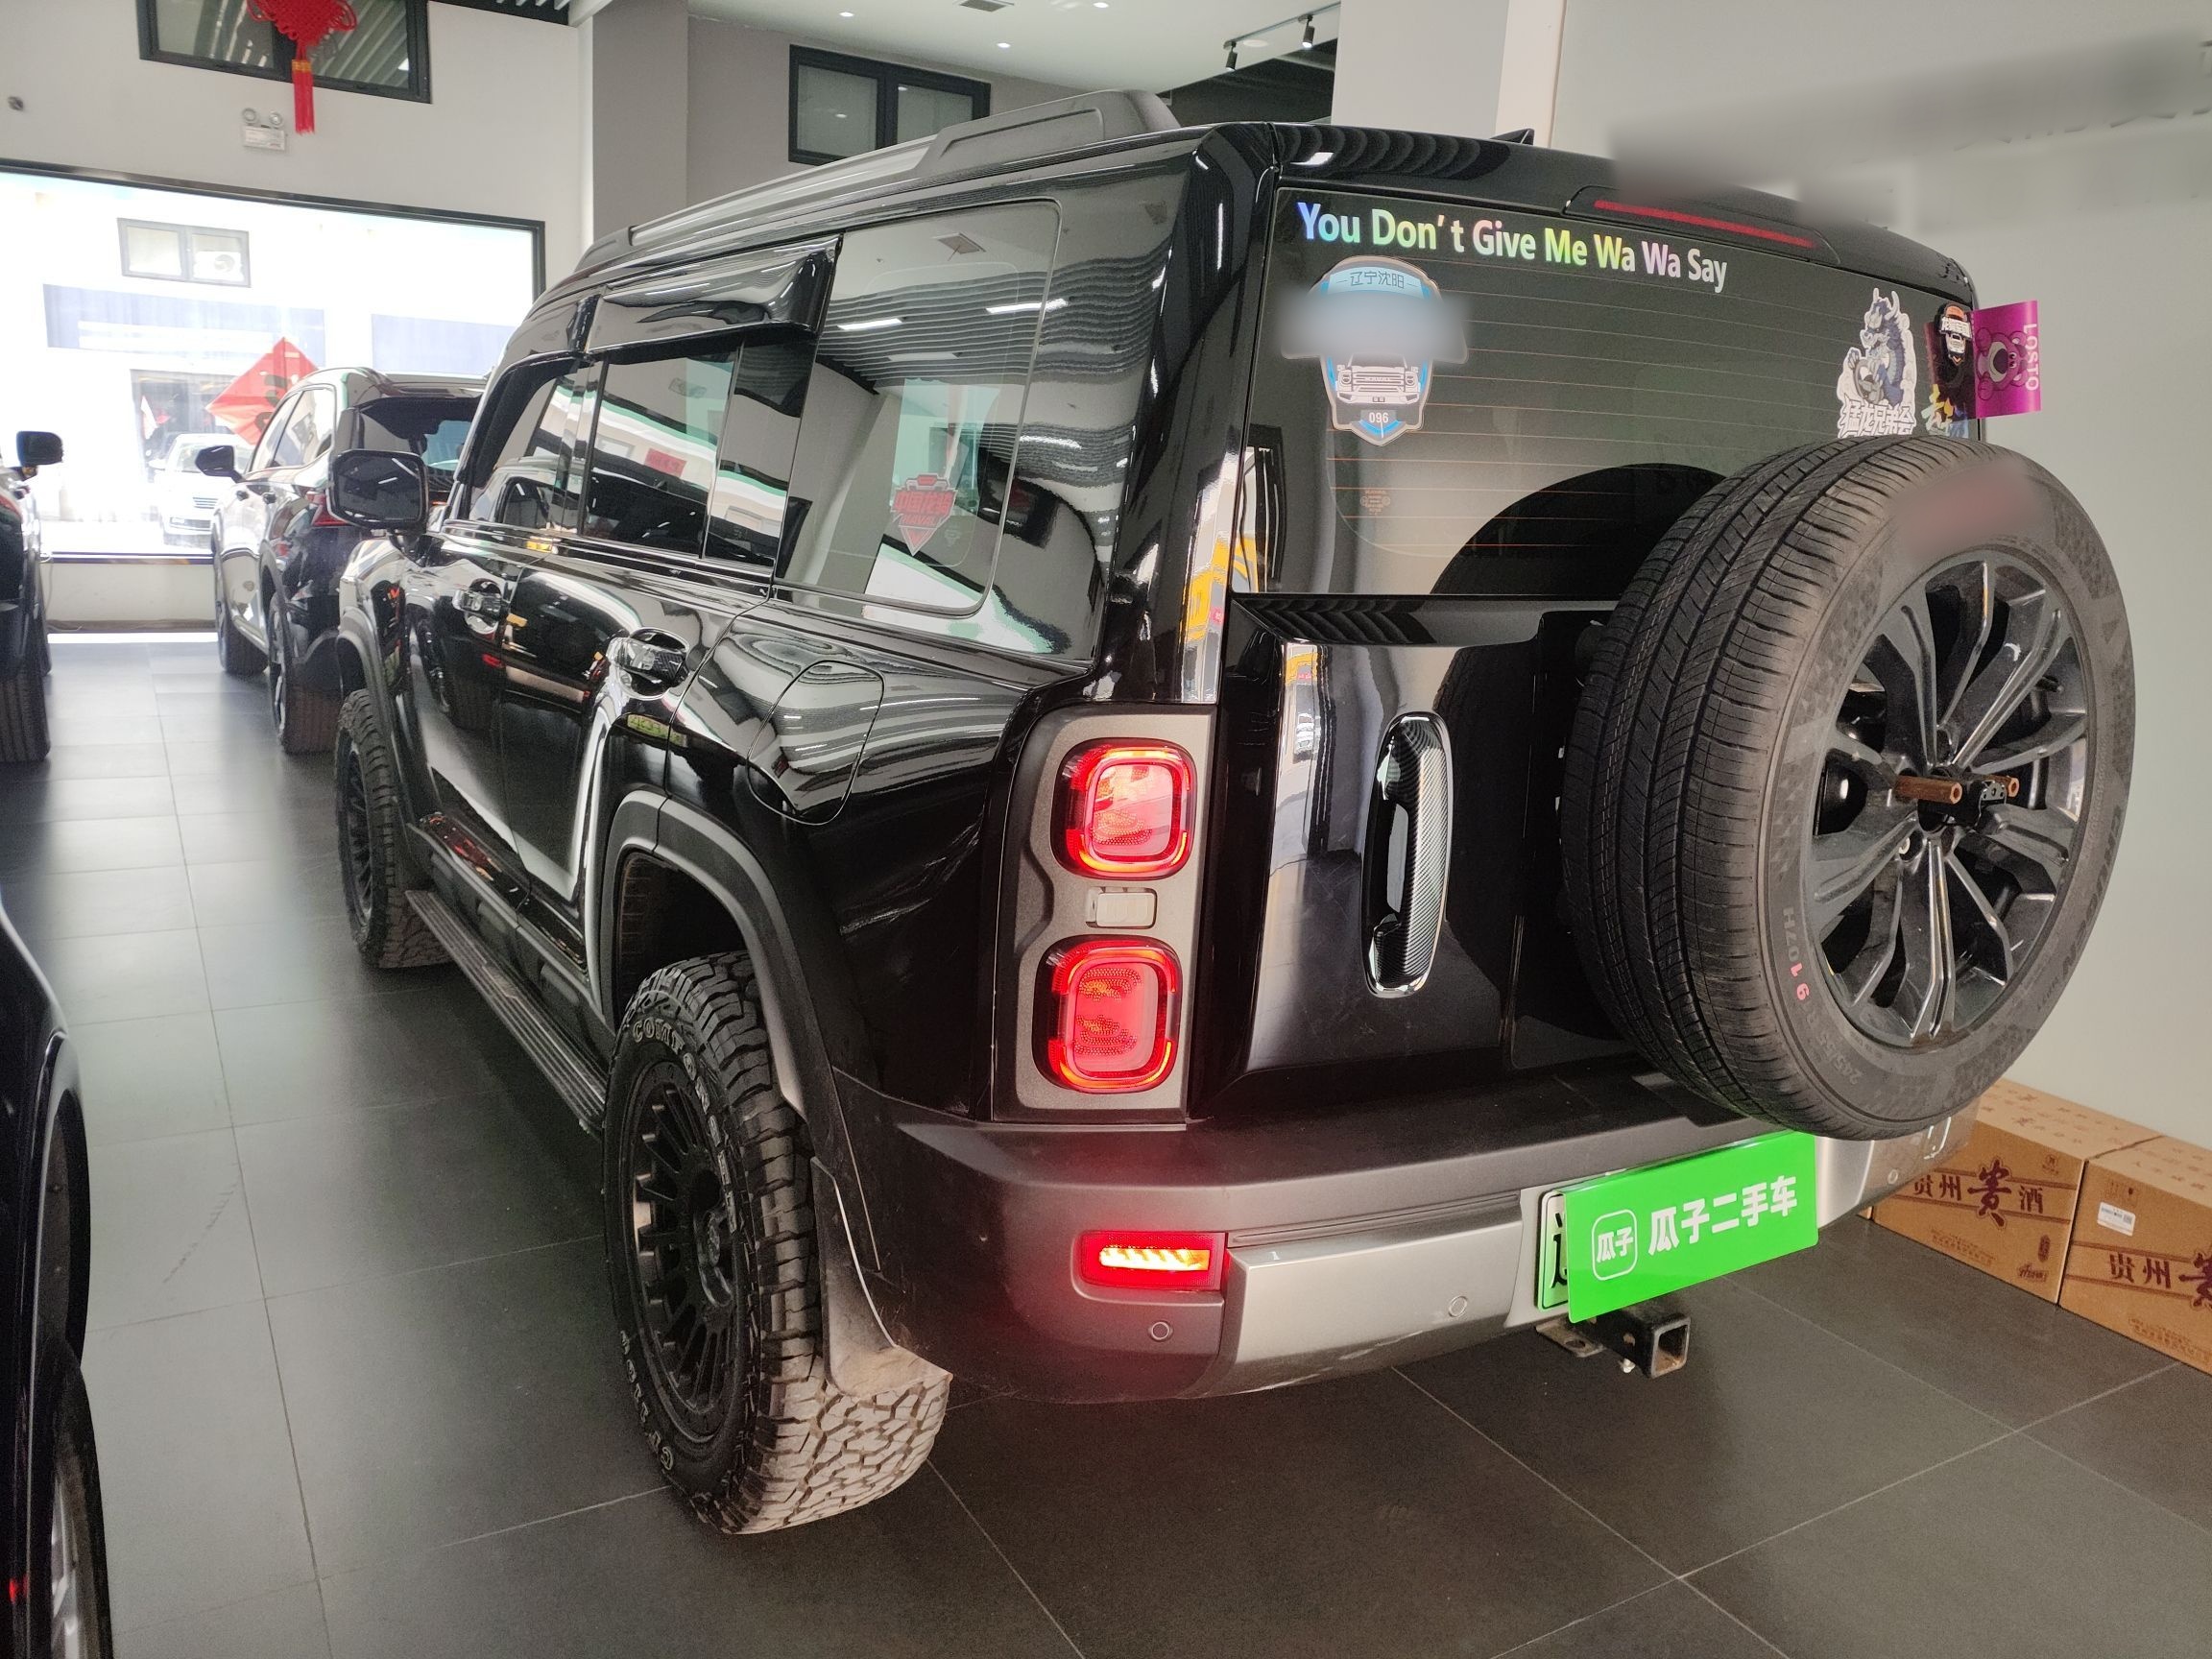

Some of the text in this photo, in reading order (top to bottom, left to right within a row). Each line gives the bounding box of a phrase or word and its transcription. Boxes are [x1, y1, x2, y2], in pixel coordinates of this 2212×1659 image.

[1298, 202, 1728, 294] You Don't Give Me Wa Wa Say
[1350, 270, 1406, 290] 辽宁沈阳
[2024, 323, 2039, 392] LOSTO
[1368, 412, 1390, 423] 096
[1647, 1175, 1798, 1257] 瓜子二手车
[1597, 1226, 1635, 1264] 瓜子
